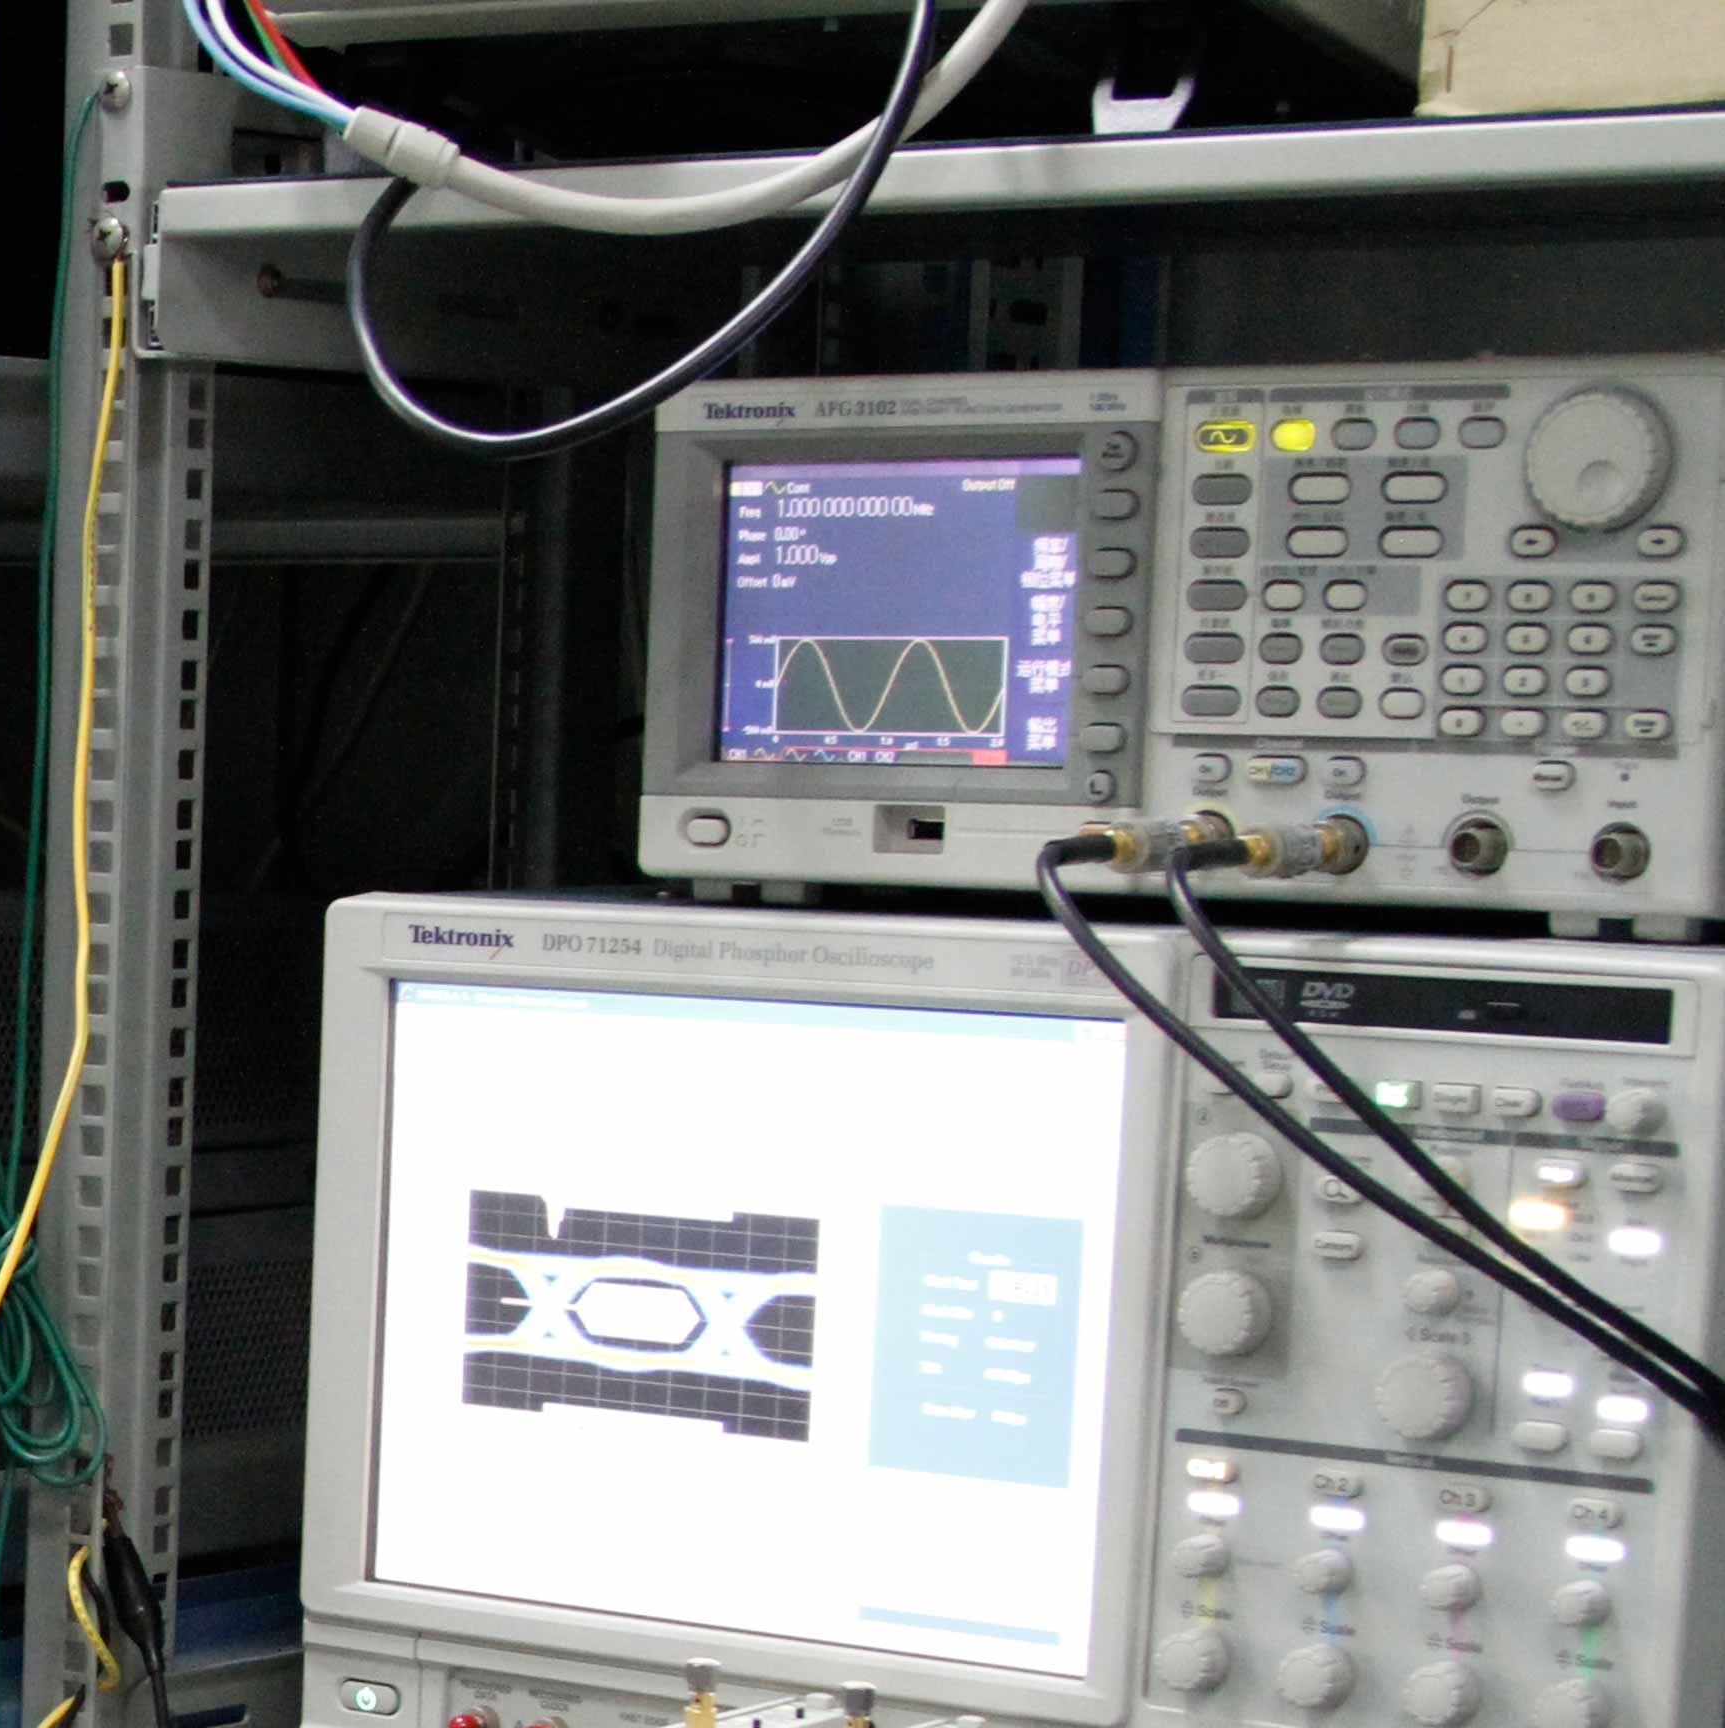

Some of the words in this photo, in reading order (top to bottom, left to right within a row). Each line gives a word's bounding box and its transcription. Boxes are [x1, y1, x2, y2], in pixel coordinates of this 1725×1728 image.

[704, 402, 796, 420] Tektronix
[815, 401, 852, 417] AFG
[855, 400, 897, 416] 3102
[738, 506, 762, 520] Freq
[738, 529, 767, 542] Phase
[737, 553, 762, 566] Ampl
[737, 576, 768, 589] Offset
[408, 924, 515, 949] Tektronix
[542, 932, 583, 954] DPO
[585, 936, 644, 957] 71254
[653, 938, 713, 961] Digital
[718, 942, 808, 968] Phosphor
[811, 946, 935, 973] Oscilloscope
[1303, 981, 1355, 999] DVD
[1314, 1472, 1338, 1491] Ch
[1337, 1475, 1350, 1491] 2
[1438, 1488, 1463, 1506] Ch
[1464, 1490, 1477, 1508] 3
[1573, 1503, 1597, 1521] Ch
[1596, 1506, 1609, 1523] 4
[1198, 1603, 1234, 1622] Scale
[1319, 1620, 1357, 1639] Scale
[1445, 1637, 1483, 1655] Scale
[1575, 1654, 1614, 1673] Scale
[473, 1690, 497, 1701] DATA
